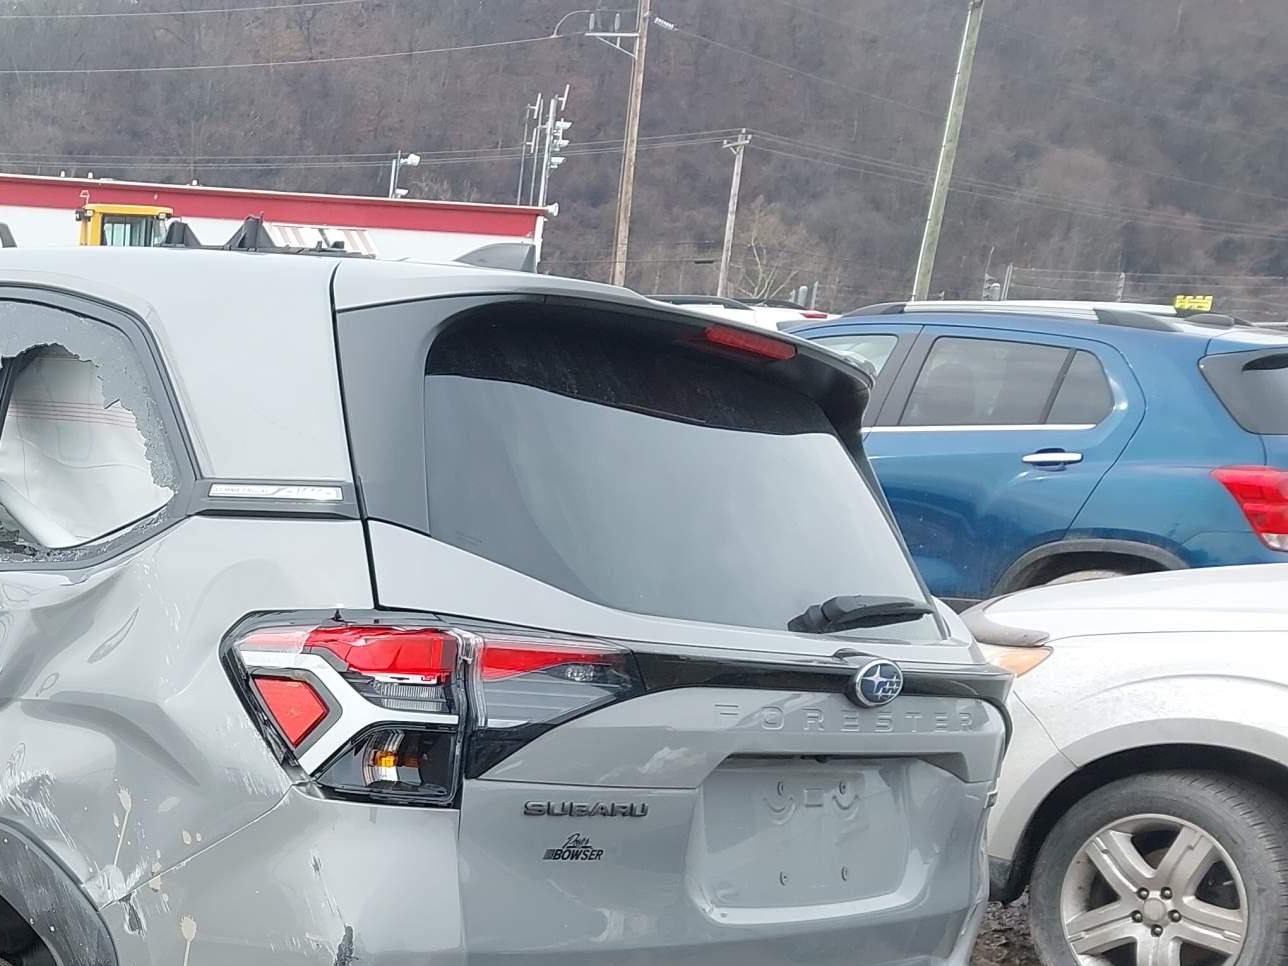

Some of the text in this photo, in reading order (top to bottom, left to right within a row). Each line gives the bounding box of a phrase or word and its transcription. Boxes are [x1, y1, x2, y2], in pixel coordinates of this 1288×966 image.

[714, 703, 974, 733] FORESTER
[523, 800, 649, 818] SUBARU
[552, 848, 604, 861] BOWSER
